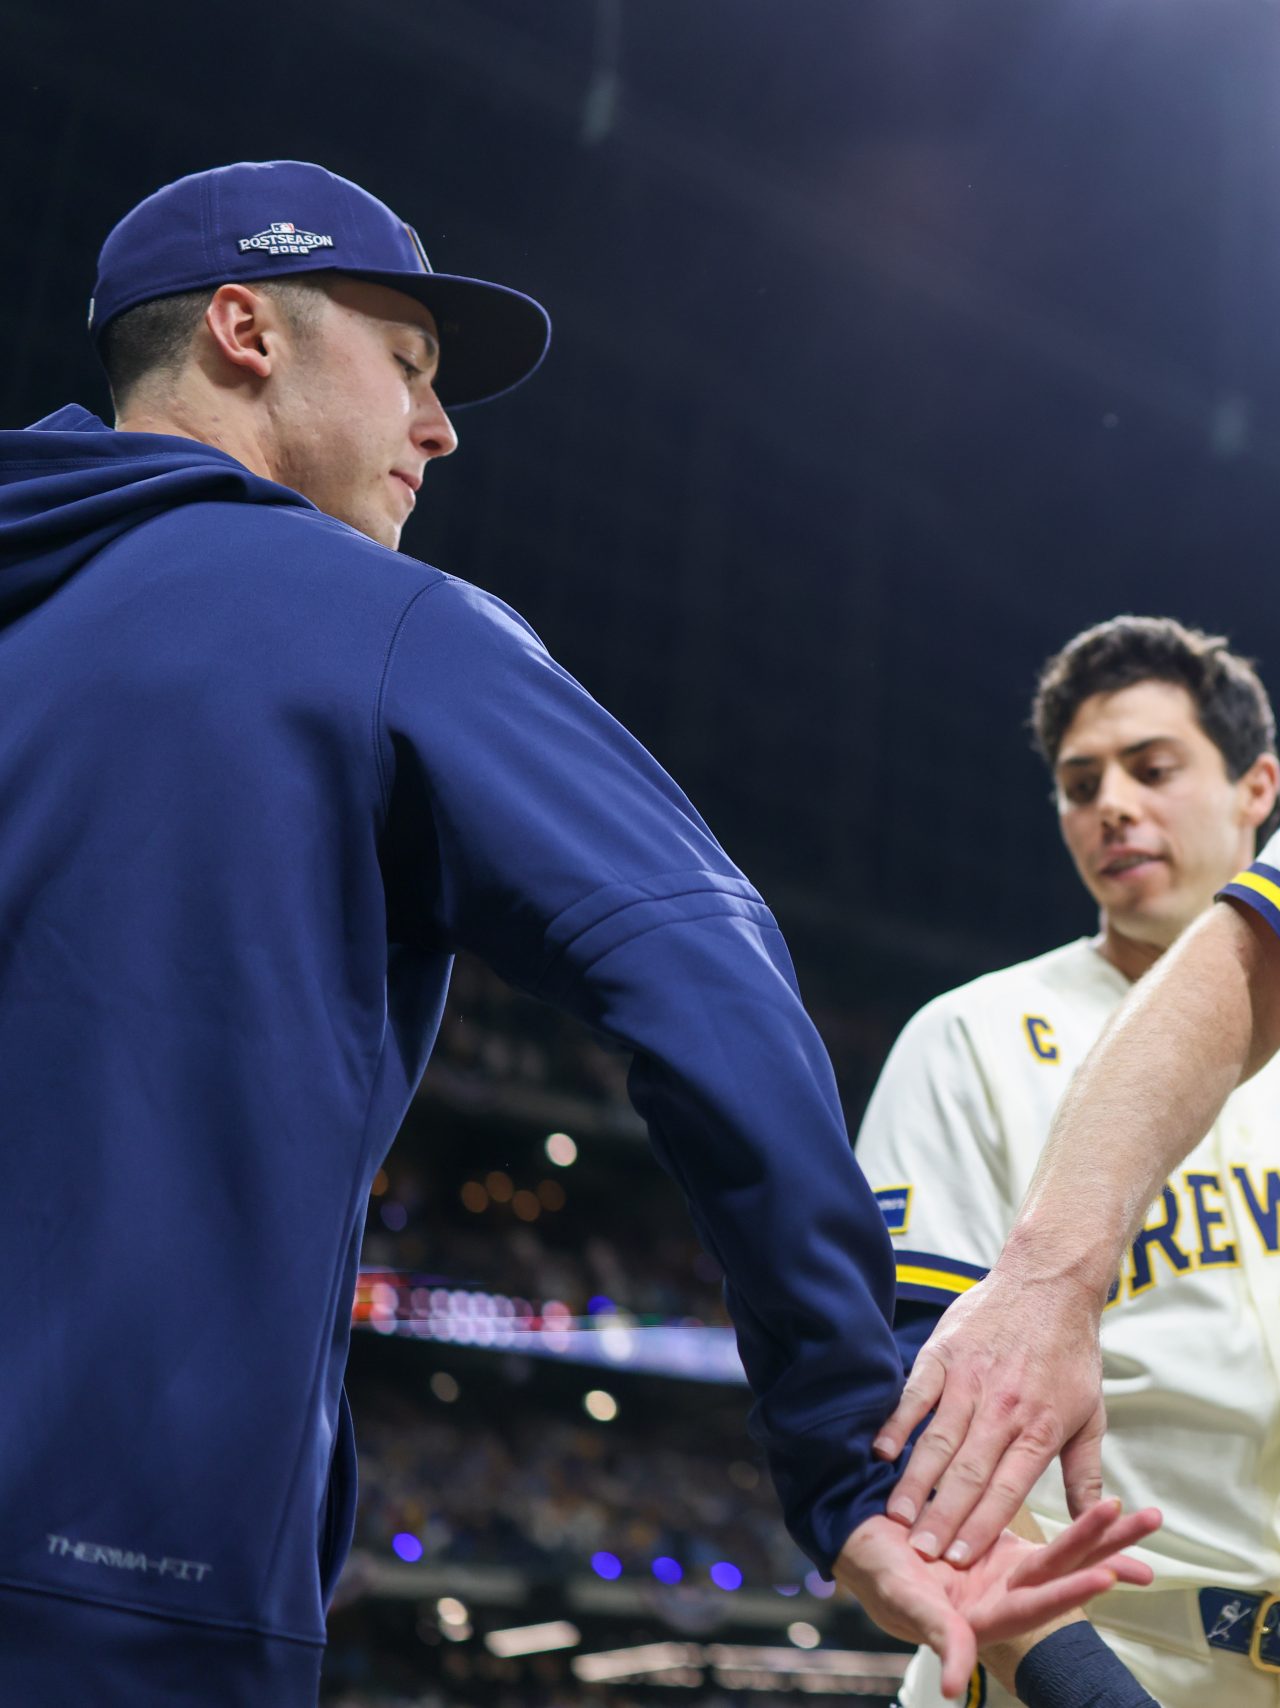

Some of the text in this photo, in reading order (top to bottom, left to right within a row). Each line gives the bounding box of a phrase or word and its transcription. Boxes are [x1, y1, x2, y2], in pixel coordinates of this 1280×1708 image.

[238, 234, 334, 251] POSTSEASON
[1022, 1013, 1060, 1066] C
[47, 1533, 213, 1582] THERMA-FIT
